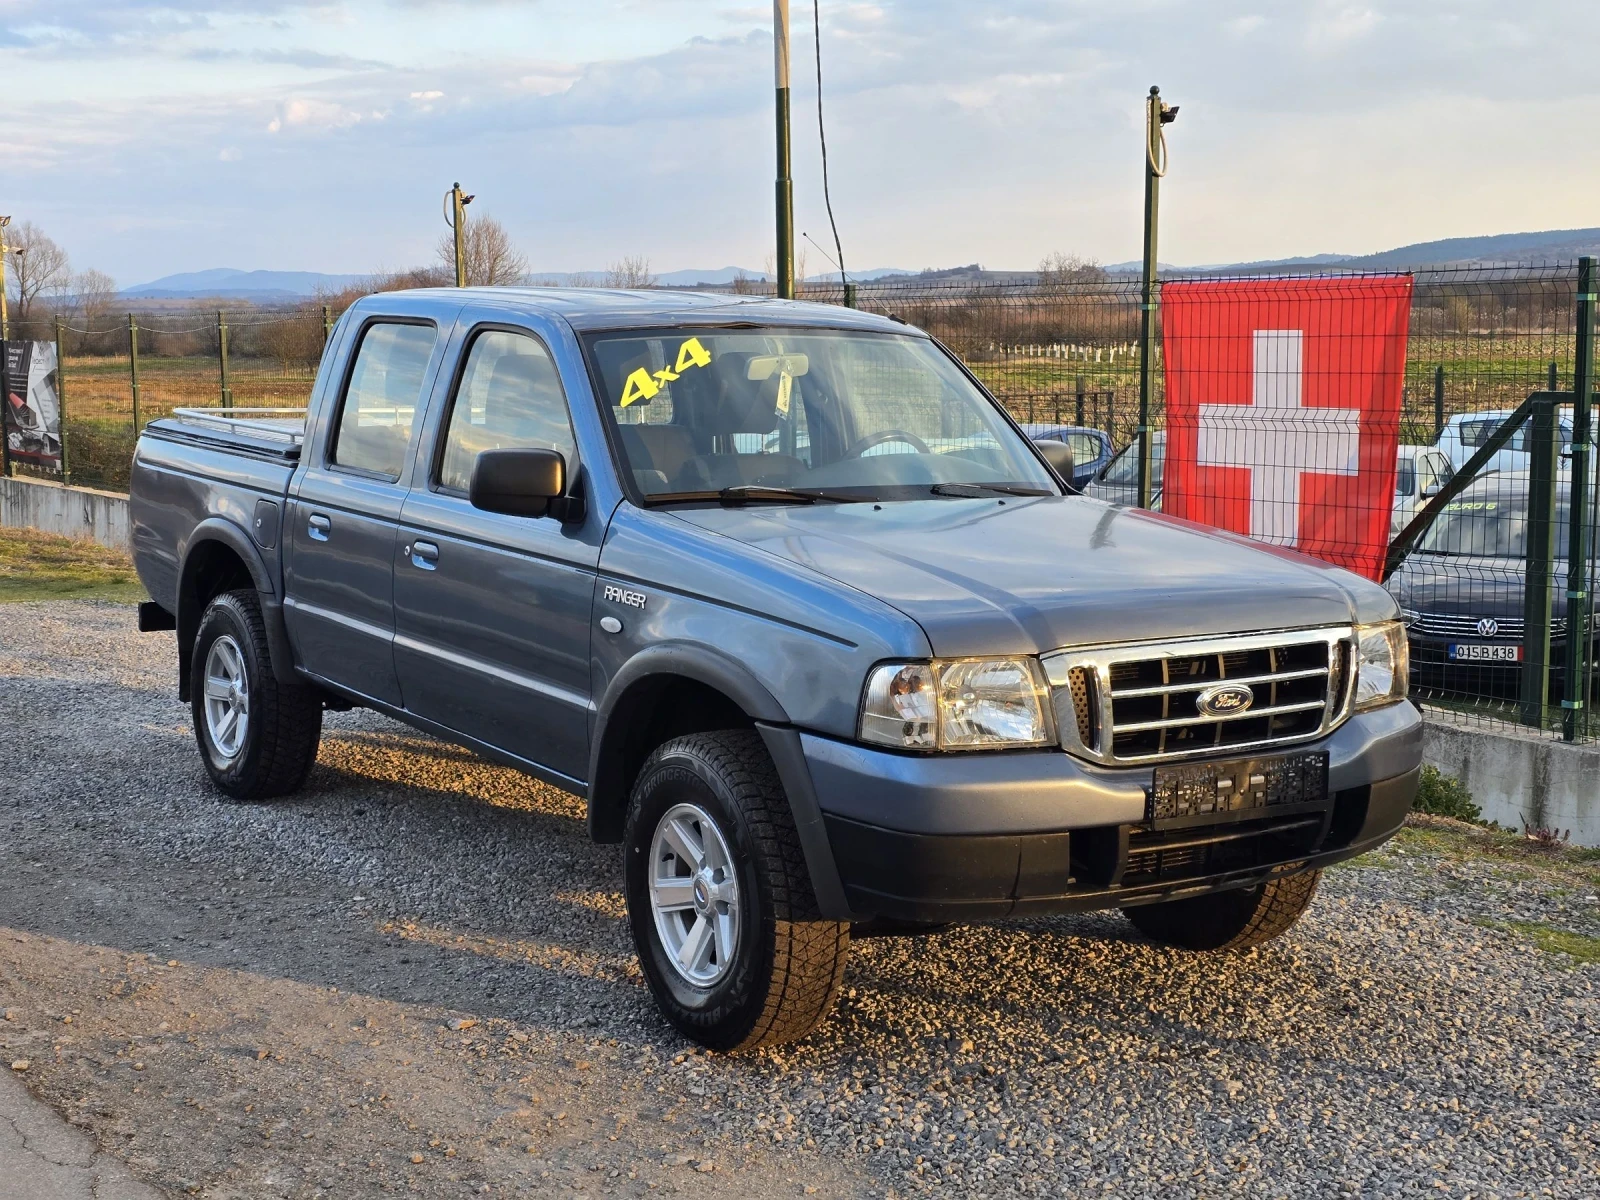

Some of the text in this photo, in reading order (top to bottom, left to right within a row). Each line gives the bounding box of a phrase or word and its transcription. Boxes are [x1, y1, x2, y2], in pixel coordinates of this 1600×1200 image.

[1485, 502, 1498, 510] 6
[603, 585, 646, 609] RANGER
[1215, 692, 1242, 708] Ford
[643, 767, 708, 799] BRIDGESTO
